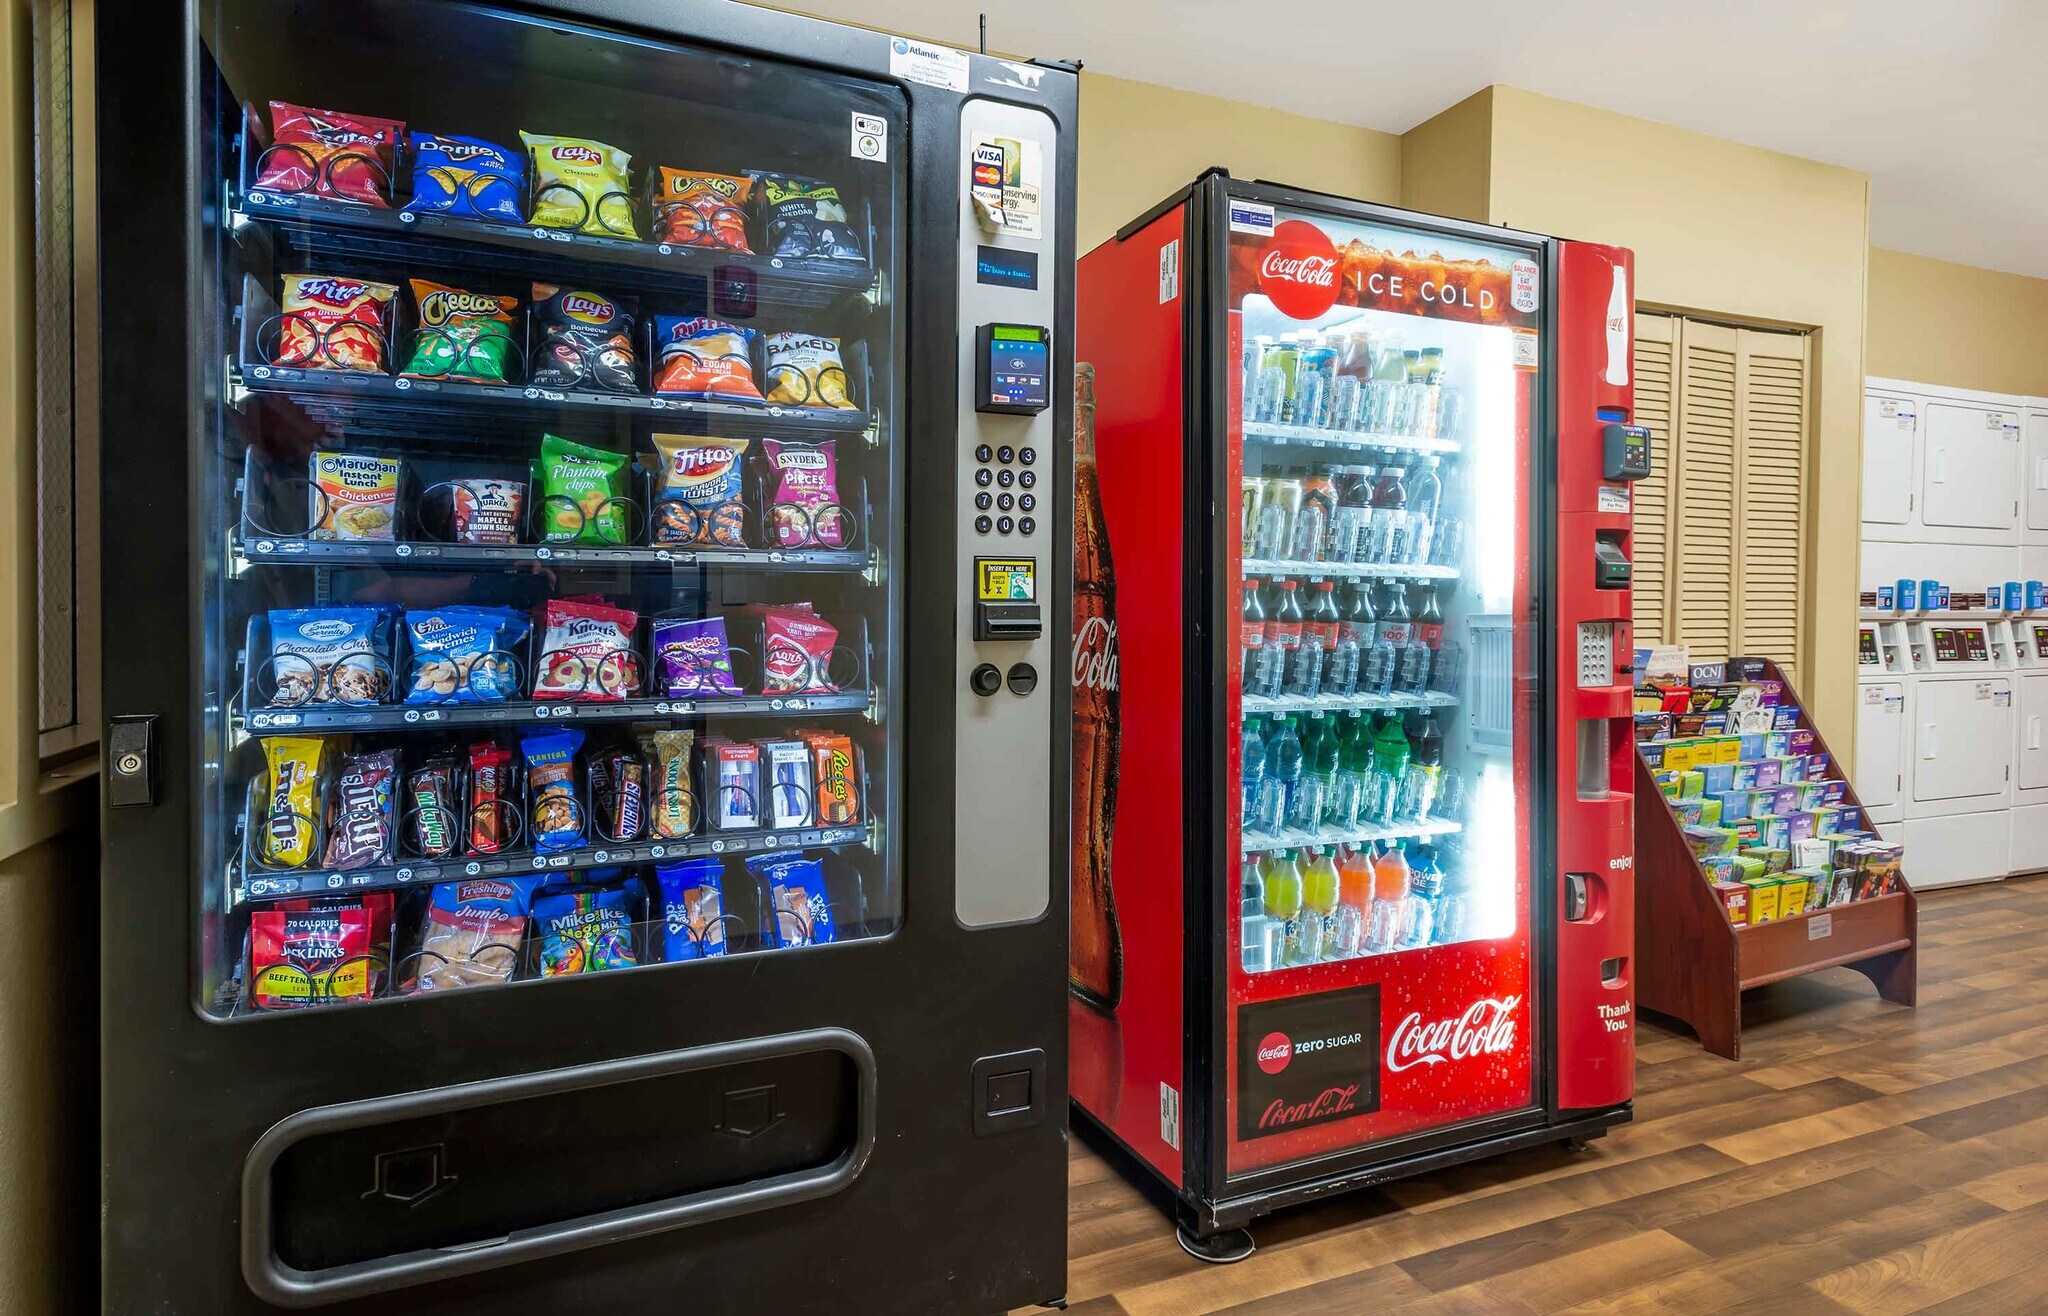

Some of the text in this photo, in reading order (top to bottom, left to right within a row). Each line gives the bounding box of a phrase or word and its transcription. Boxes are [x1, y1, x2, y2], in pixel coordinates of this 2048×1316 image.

[909, 46, 940, 60] Atlantic
[866, 121, 881, 132] Pay
[419, 142, 505, 163] Doritos
[977, 150, 1001, 163] VISA
[564, 168, 599, 178] Classic
[779, 203, 806, 213] WHITE
[1261, 249, 1338, 288] Coca-Cola
[1514, 264, 1537, 275] BALANCE
[1517, 283, 1533, 292] DRINK
[1520, 277, 1529, 285] EAT
[1356, 270, 1495, 310] ICE COLD
[422, 292, 500, 328] Cheetos
[566, 296, 612, 317] Lay's
[570, 324, 608, 334] Barbecue
[766, 338, 836, 357] BAKED
[673, 447, 735, 475] Fritos
[982, 447, 1032, 461] 1 2 3
[336, 457, 396, 474] Maruchan
[553, 464, 608, 480] Plantain
[340, 470, 382, 480] Instant
[981, 471, 1032, 485] 4 5 6
[344, 478, 378, 488] Lunch
[565, 480, 596, 493] chips
[681, 479, 728, 499] TWISTS
[690, 476, 724, 491] FLAVOR
[339, 488, 380, 501] Chicken
[982, 494, 1032, 508] 7 8 9
[480, 499, 508, 508] UAKER
[469, 523, 516, 532] BROWN SUGAR
[1002, 519, 1010, 530] 0
[987, 564, 1004, 572] INSERT
[1885, 598, 1891, 606] 6
[306, 629, 346, 637] Serenity
[309, 622, 340, 631] Sweet
[425, 627, 477, 644] Sandwich
[431, 631, 448, 640] Mini
[275, 643, 340, 654] Chocolate
[1692, 665, 1722, 680] OCNJ
[256, 717, 267, 725] 40
[667, 757, 682, 789] DOONE
[832, 748, 850, 804] Reese's
[622, 780, 641, 839] SNICKERS
[468, 864, 479, 872] 53
[1609, 855, 1633, 870] enjoy
[253, 884, 265, 892] 50
[461, 884, 513, 898] Freshley's
[454, 905, 509, 922] Jumbo
[550, 908, 626, 931] Mike Ike
[287, 920, 339, 928] 70 CALORIES
[462, 920, 496, 929] Honey Bun
[560, 924, 602, 942] Mega
[280, 946, 345, 960] JACK LINK'S
[268, 973, 289, 982] BEEF
[1597, 1000, 1631, 1019] Thank
[1386, 993, 1523, 1072] Coca-Cola
[1604, 1018, 1628, 1033] You.
[1257, 1033, 1361, 1062] Coca-Cola zero SUGAR
